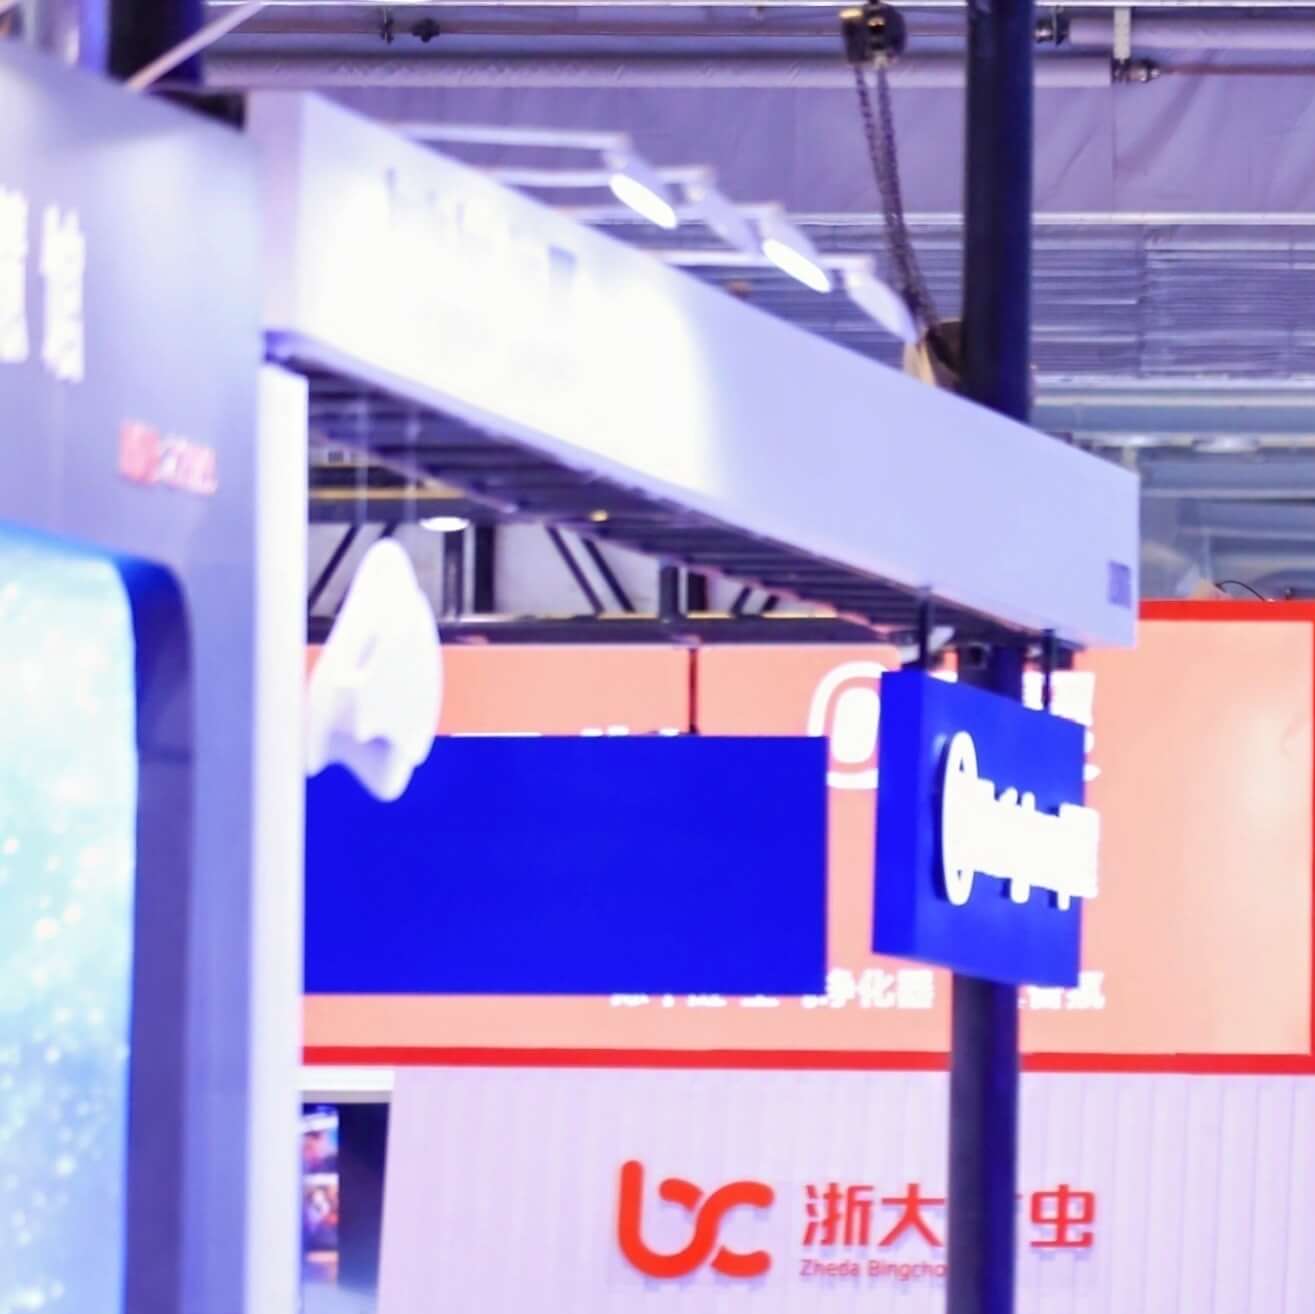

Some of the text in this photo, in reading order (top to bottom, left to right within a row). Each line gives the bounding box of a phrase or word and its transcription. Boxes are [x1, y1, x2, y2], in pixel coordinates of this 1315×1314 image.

[801, 1182, 1097, 1248] 浙大虫
[800, 1258, 860, 1277] Zheda
